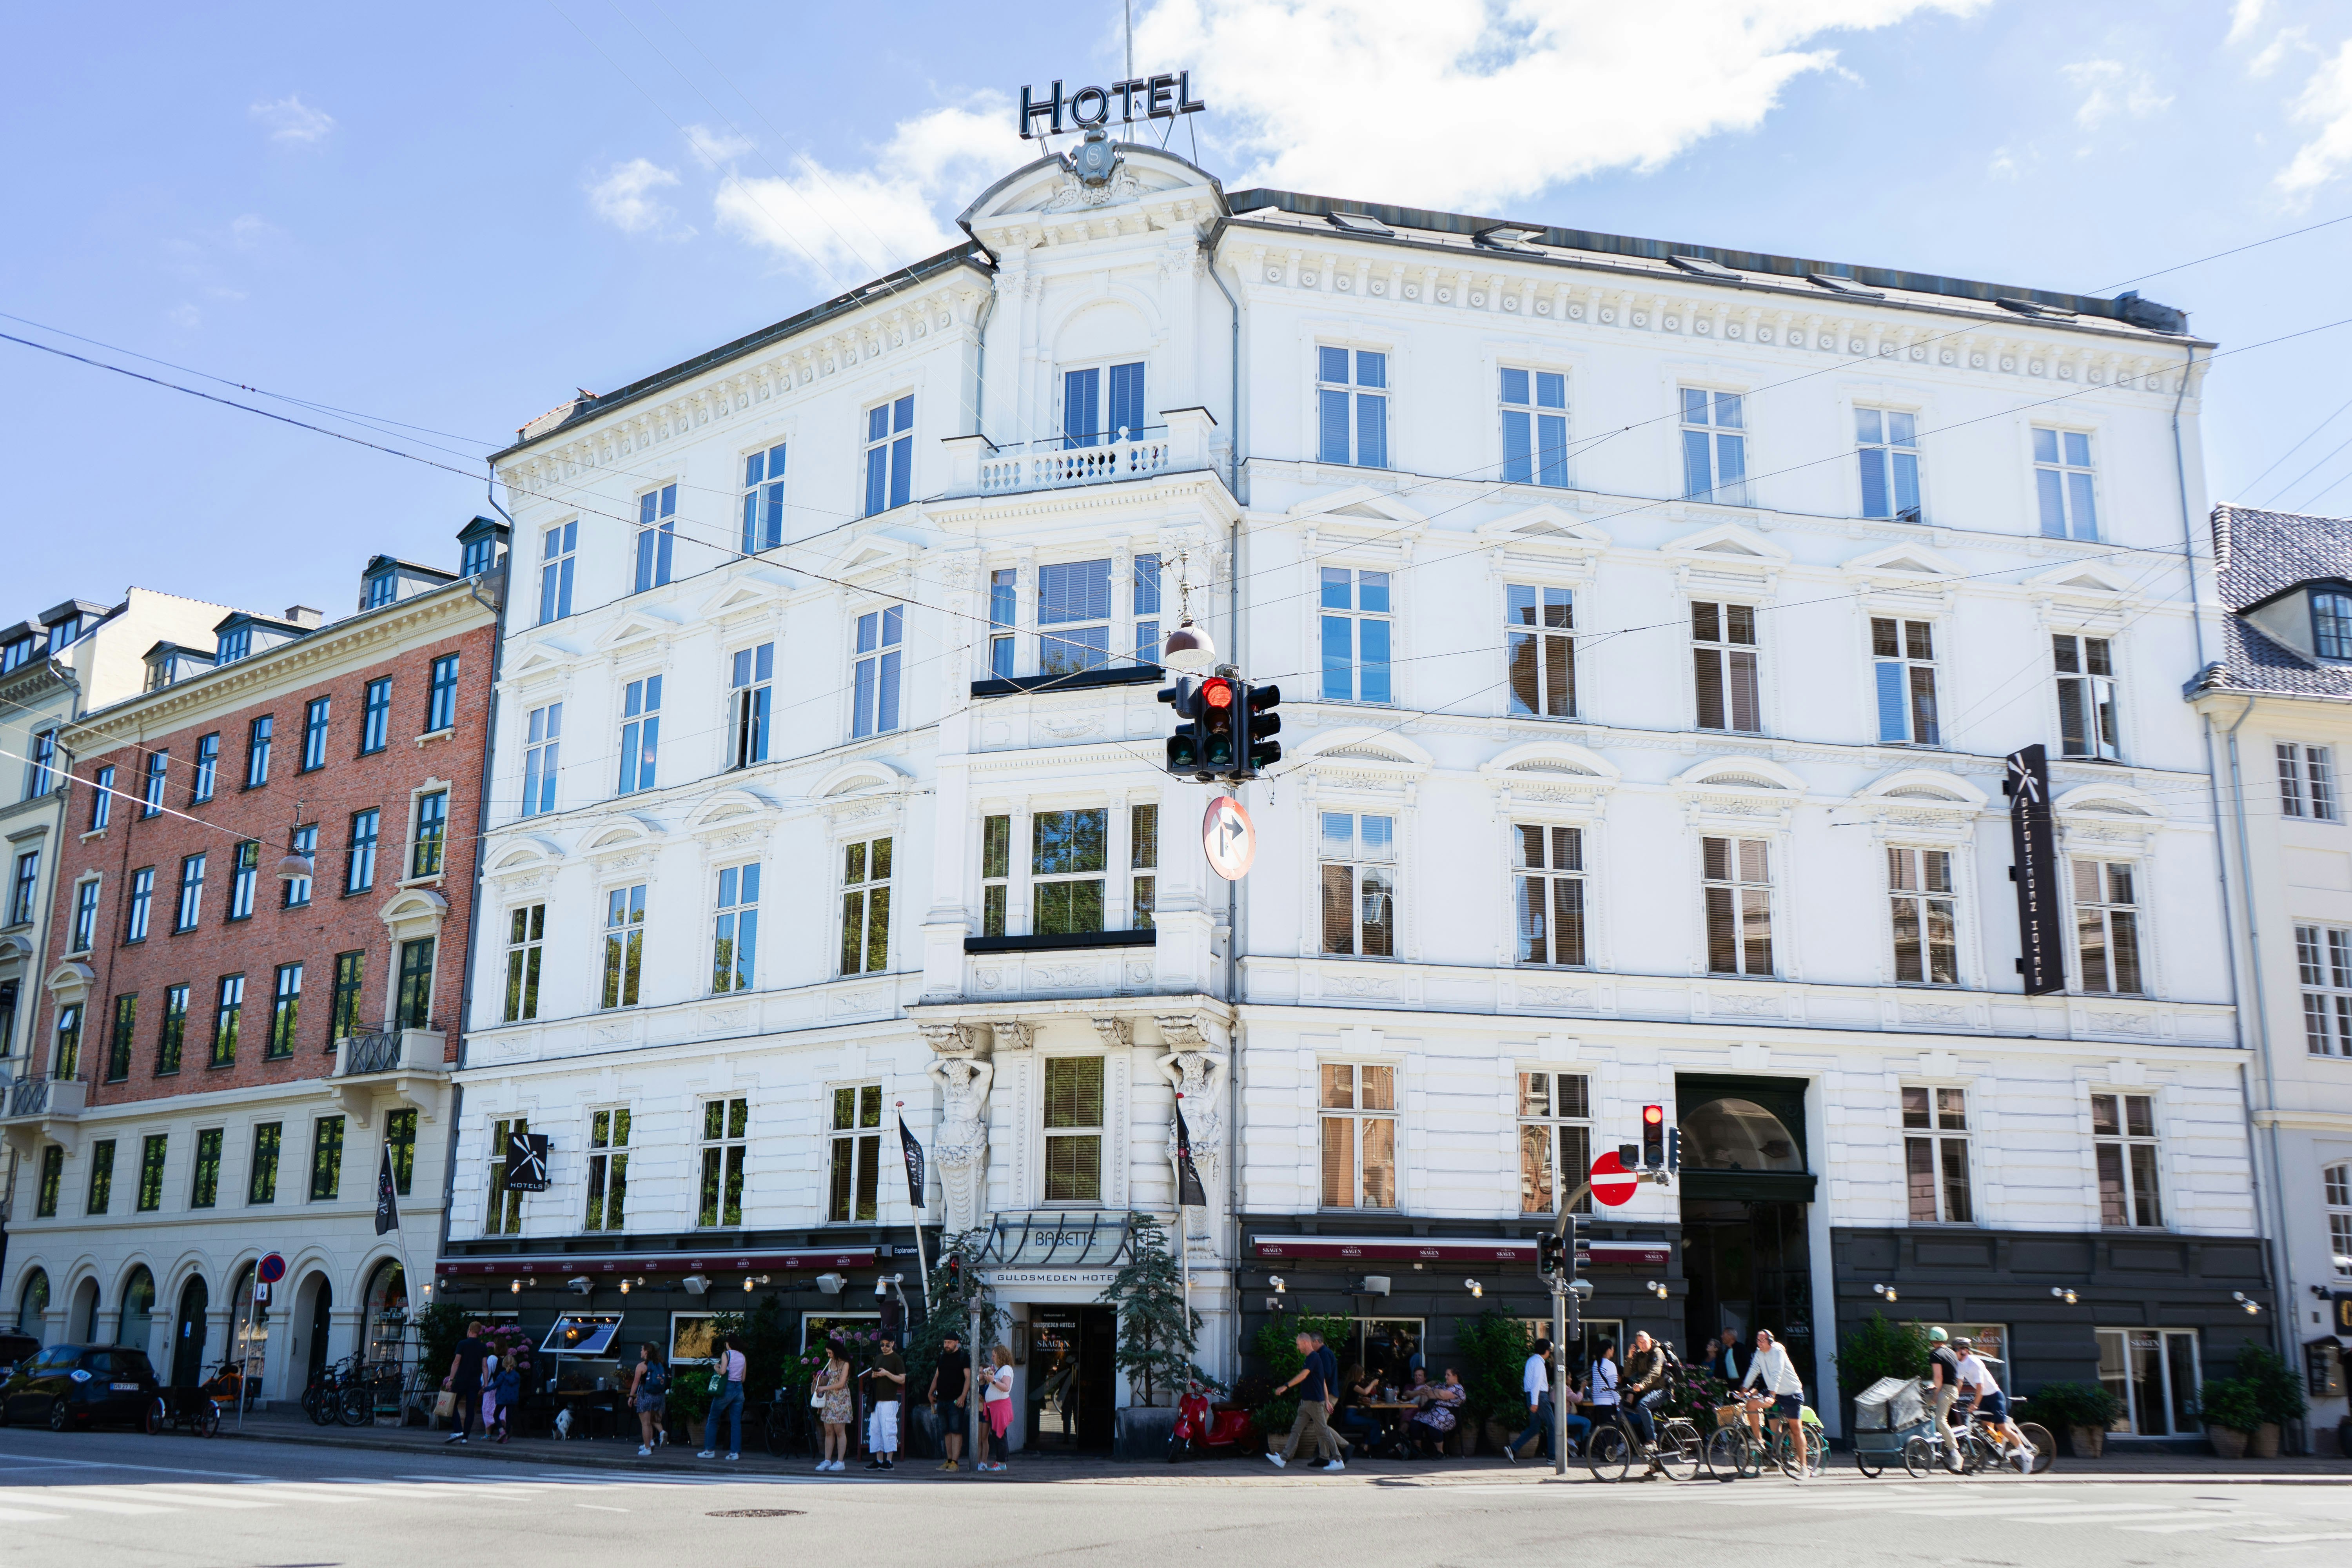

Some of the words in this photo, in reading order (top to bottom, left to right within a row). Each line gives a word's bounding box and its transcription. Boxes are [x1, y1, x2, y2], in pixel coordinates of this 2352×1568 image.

[1019, 70, 1206, 140] HOTEL
[2021, 797, 2037, 912] GULDSMEDEN
[2031, 920, 2043, 986] HOTELS
[1035, 1232, 1096, 1246] BABETTE
